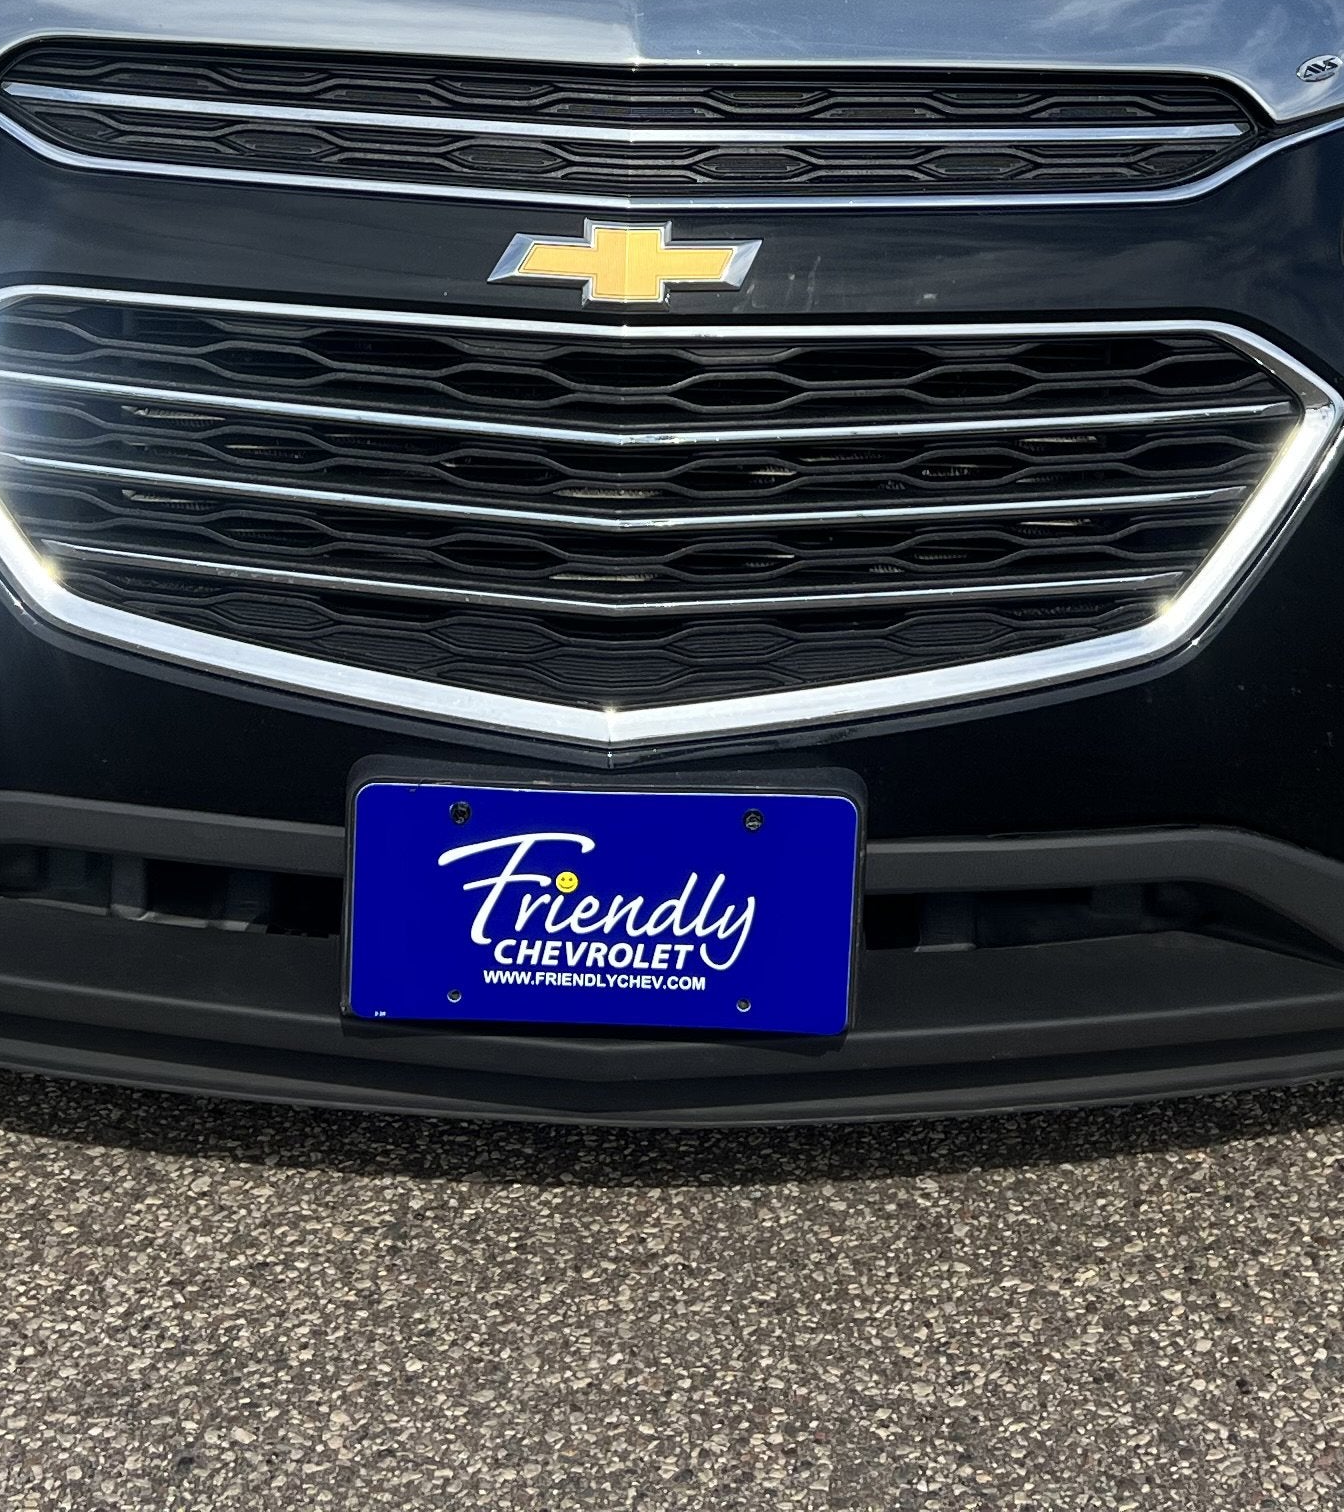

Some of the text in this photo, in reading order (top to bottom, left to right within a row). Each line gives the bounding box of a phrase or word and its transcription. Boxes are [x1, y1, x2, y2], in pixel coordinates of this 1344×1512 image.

[437, 832, 756, 971] Friendly
[493, 938, 695, 970] CHEVROLET
[483, 969, 706, 991] WWW.FRIENDLYCHEV.COM
